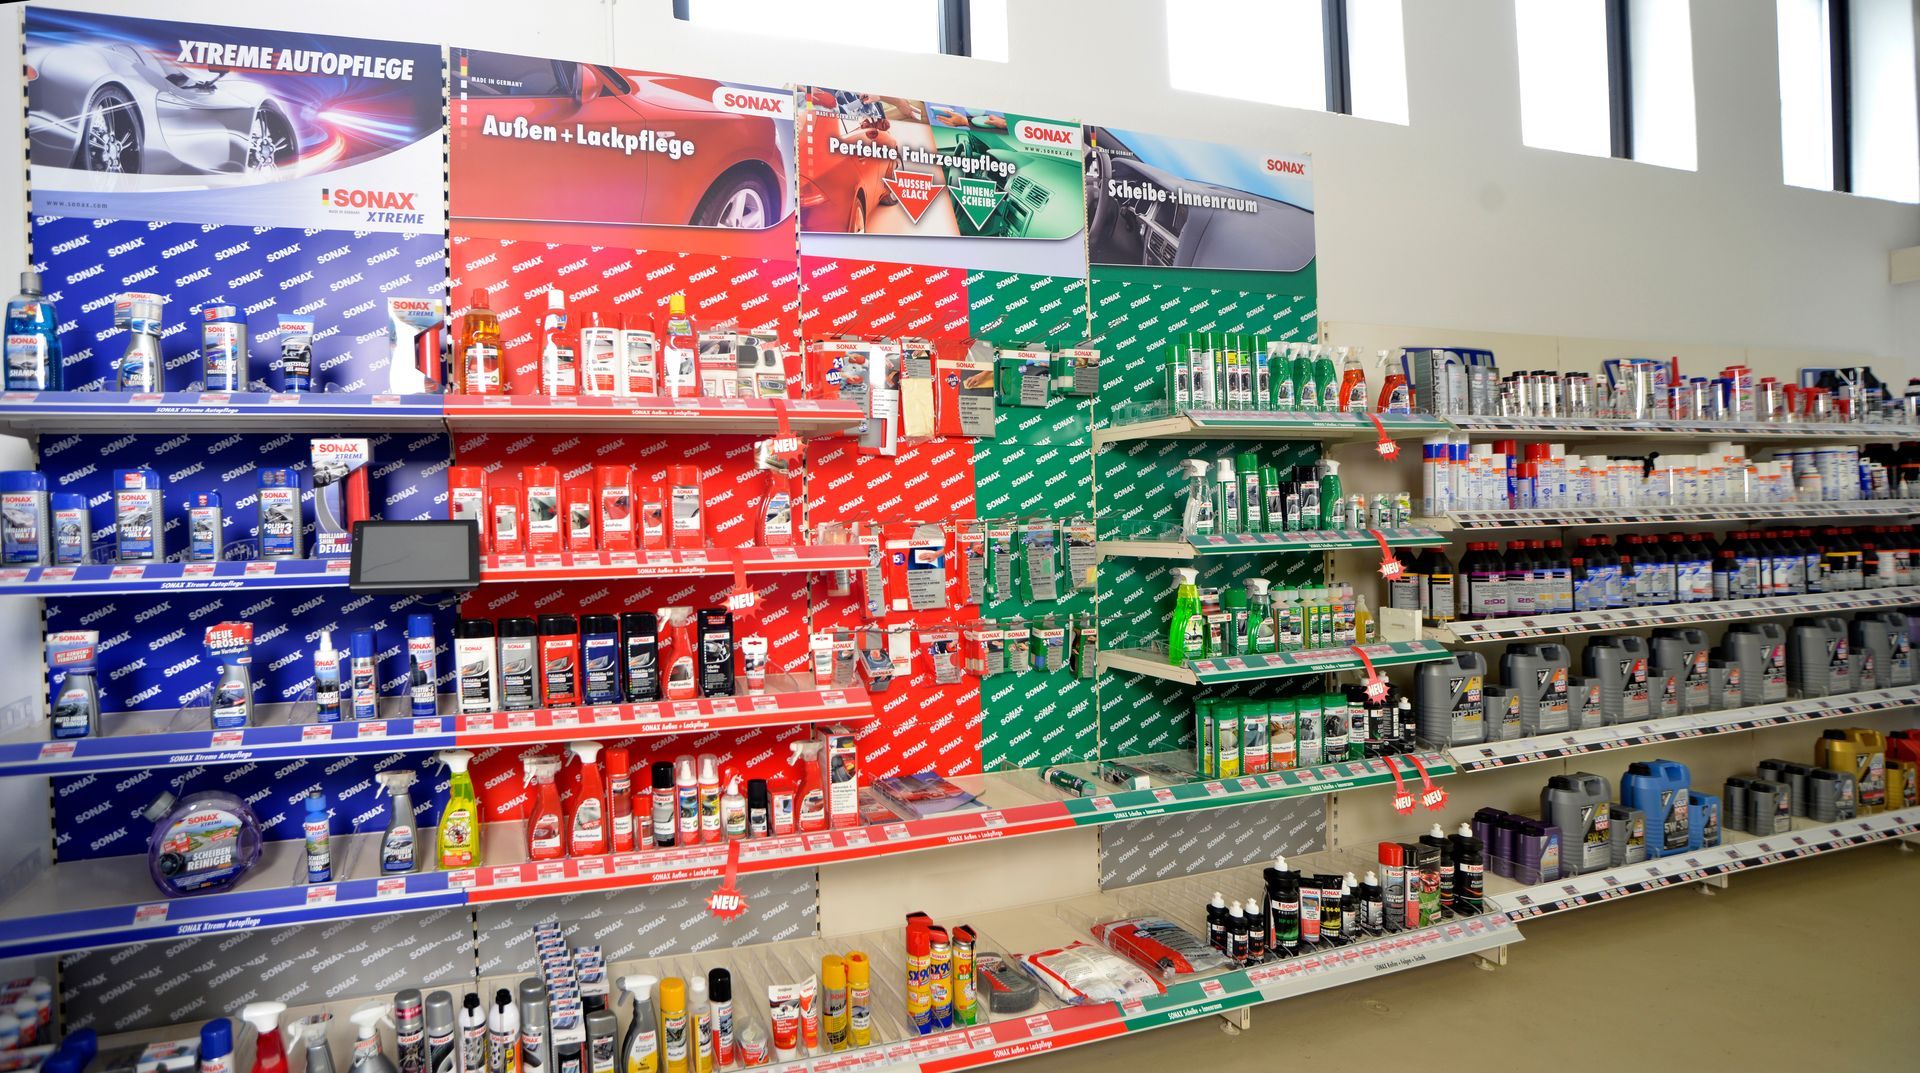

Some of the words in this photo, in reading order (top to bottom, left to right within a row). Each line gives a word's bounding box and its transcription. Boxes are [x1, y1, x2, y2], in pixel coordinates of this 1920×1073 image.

[176, 40, 272, 69] XTREME
[276, 49, 414, 80] AUTOPFLEGE
[497, 79, 522, 87] GERMANY
[724, 93, 782, 112] SONAX
[482, 115, 556, 141] Außen
[577, 124, 695, 159] Lackpflege
[1024, 126, 1072, 144] SONAX
[829, 138, 897, 160] Perfekte
[902, 147, 1016, 177] Fahrzeugpflege
[1025, 146, 1073, 156] www.sonax.de
[1267, 159, 1304, 175] SONAX
[898, 177, 931, 190] AUSSEN
[334, 188, 416, 210] SONAX
[901, 189, 928, 200] &LACK
[963, 187, 994, 197] INNEN&
[1108, 180, 1166, 202] Scheibe
[1178, 187, 1258, 213] Innenraum
[961, 198, 996, 208] SCHEIBE
[366, 212, 424, 224] XTREME
[52, 237, 90, 255] SONAX
[108, 237, 145, 257] SONAX
[162, 239, 198, 259] SONAX
[214, 241, 251, 260] SONAX
[267, 243, 301, 262] SONAX
[366, 246, 400, 267] SONAX
[466, 253, 497, 271] SONAX
[512, 256, 544, 273] SONAX
[558, 258, 589, 275] SONAX
[603, 261, 633, 278] SONAX
[646, 263, 676, 281] SONAX
[689, 266, 718, 283] SONAX
[812, 262, 838, 278] SONAX
[851, 264, 877, 280] SONAX
[122, 265, 159, 286] SONAX
[229, 269, 264, 288] SONAX
[330, 272, 363, 291] SONAX
[731, 269, 759, 286] SONAX
[925, 269, 950, 285] SONAX
[961, 271, 985, 287] SONAX
[996, 274, 1020, 289] SONAX
[1030, 276, 1053, 291] SONAX
[569, 285, 600, 302] SONAX
[613, 287, 644, 304] SONAX
[898, 290, 923, 306] SONAX
[343, 300, 376, 319] SONAX
[393, 301, 429, 311] SONAX
[1005, 296, 1029, 312] SONAX
[1160, 297, 1181, 311] SONAX
[1218, 302, 1238, 316] SONAX
[319, 443, 358, 453] SONAX
[774, 438, 798, 451] NEU
[1379, 443, 1395, 454] NEU
[895, 448, 920, 465] SONAX
[931, 449, 956, 465] SONAX
[1002, 449, 1026, 464] SONAX
[142, 527, 151, 537] 2
[284, 523, 293, 534] 3
[1382, 563, 1399, 575] NEU
[209, 580, 244, 588] Autopflege
[729, 593, 755, 610] NEU
[210, 630, 233, 640] NEUE
[210, 638, 244, 649] GRÖSSE
[1367, 683, 1385, 697] NEU
[170, 754, 193, 762] SONAX
[219, 751, 252, 760] Autopflege
[1396, 797, 1411, 809] NEU
[1423, 790, 1442, 804] NEU
[188, 813, 219, 825] SONAX
[193, 846, 232, 861] SCHEIBEN
[187, 854, 232, 871] REINIGER
[694, 868, 719, 876] Lackpflege
[712, 895, 739, 910] NEU
[178, 924, 202, 934] SONAX
[203, 921, 225, 931] Xtreme
[227, 917, 260, 929] Autopflege
